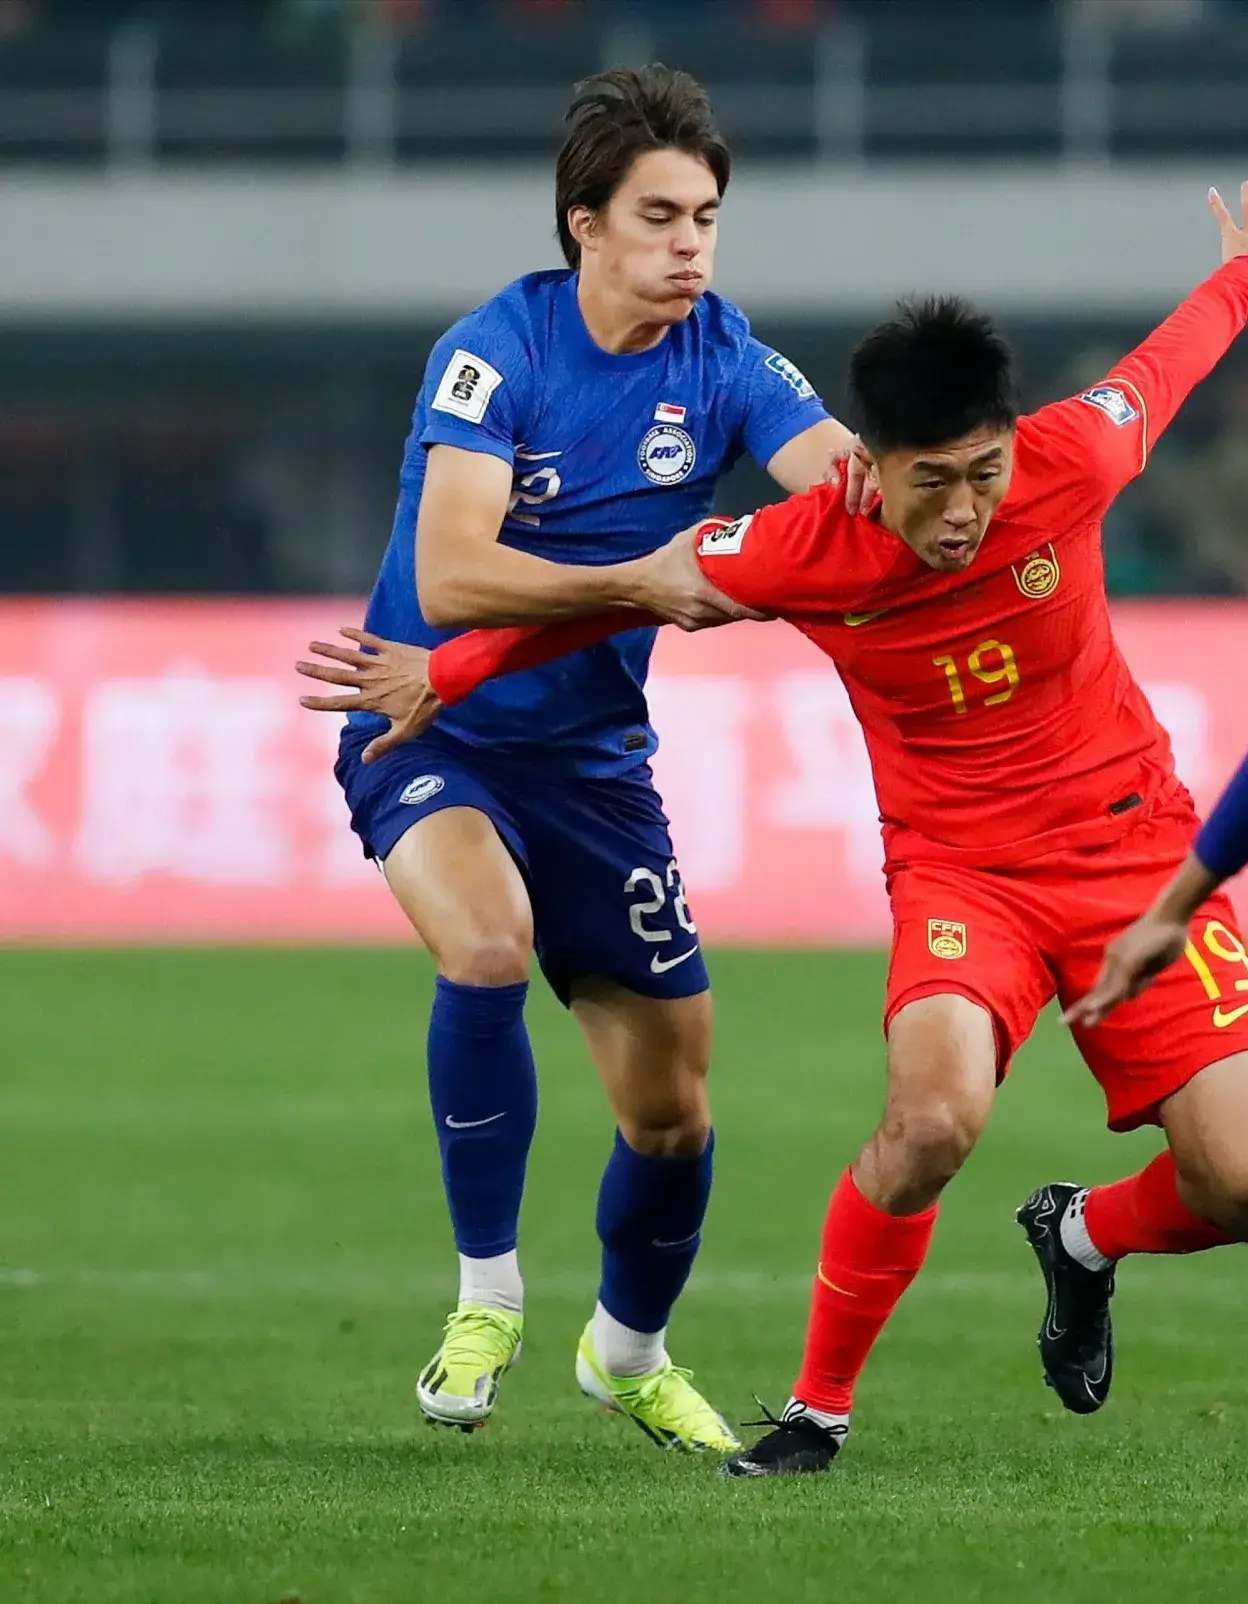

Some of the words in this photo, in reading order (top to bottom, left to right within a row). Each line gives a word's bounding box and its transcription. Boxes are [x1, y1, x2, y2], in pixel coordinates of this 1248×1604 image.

[662, 427, 693, 464] ASSOCIATION
[645, 468, 685, 483] SINGAPORE
[932, 639, 1020, 714] 19
[931, 921, 962, 934] CFA
